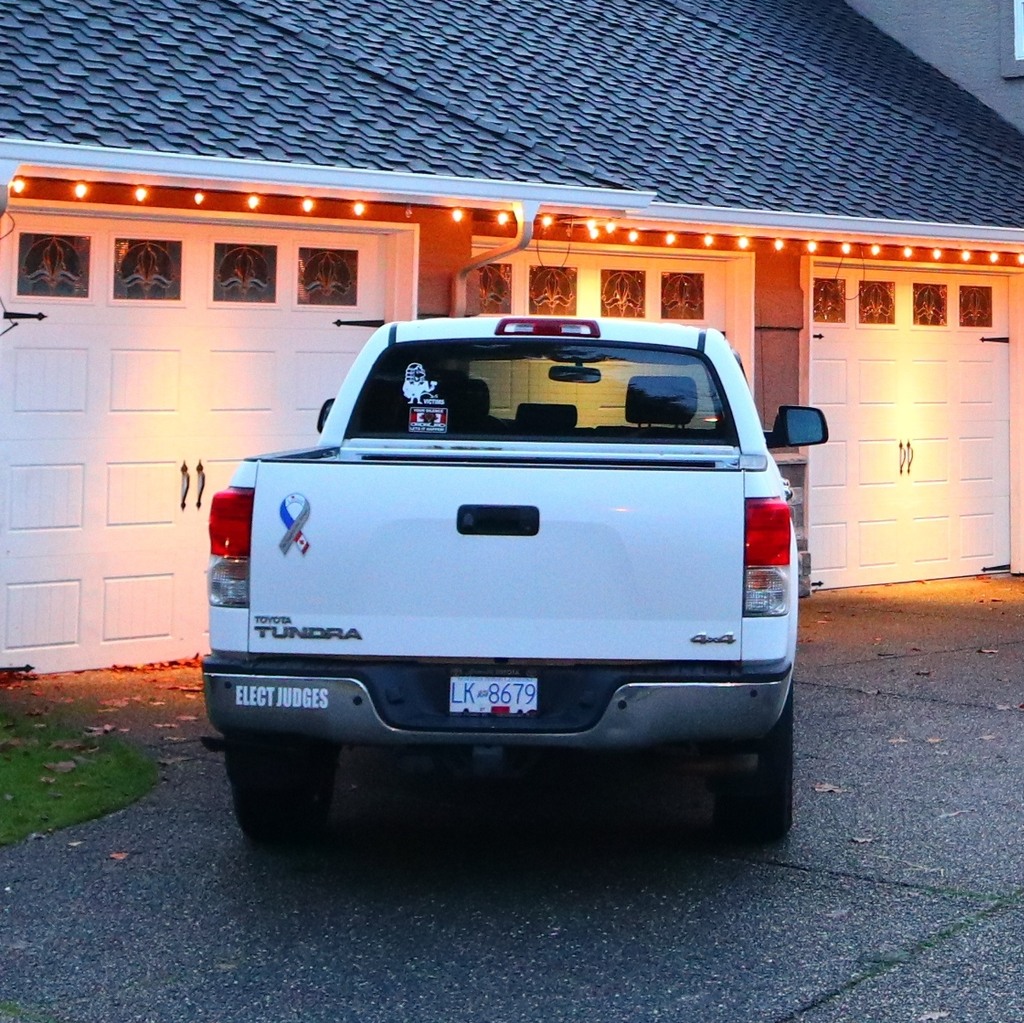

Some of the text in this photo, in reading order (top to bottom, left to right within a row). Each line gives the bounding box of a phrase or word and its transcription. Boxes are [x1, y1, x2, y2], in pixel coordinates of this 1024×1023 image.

[254, 616, 292, 625] TOYOTA
[254, 626, 363, 640] TUNDRA
[235, 685, 329, 709] ELECT JUDGES
[451, 682, 536, 704] LK 8679
